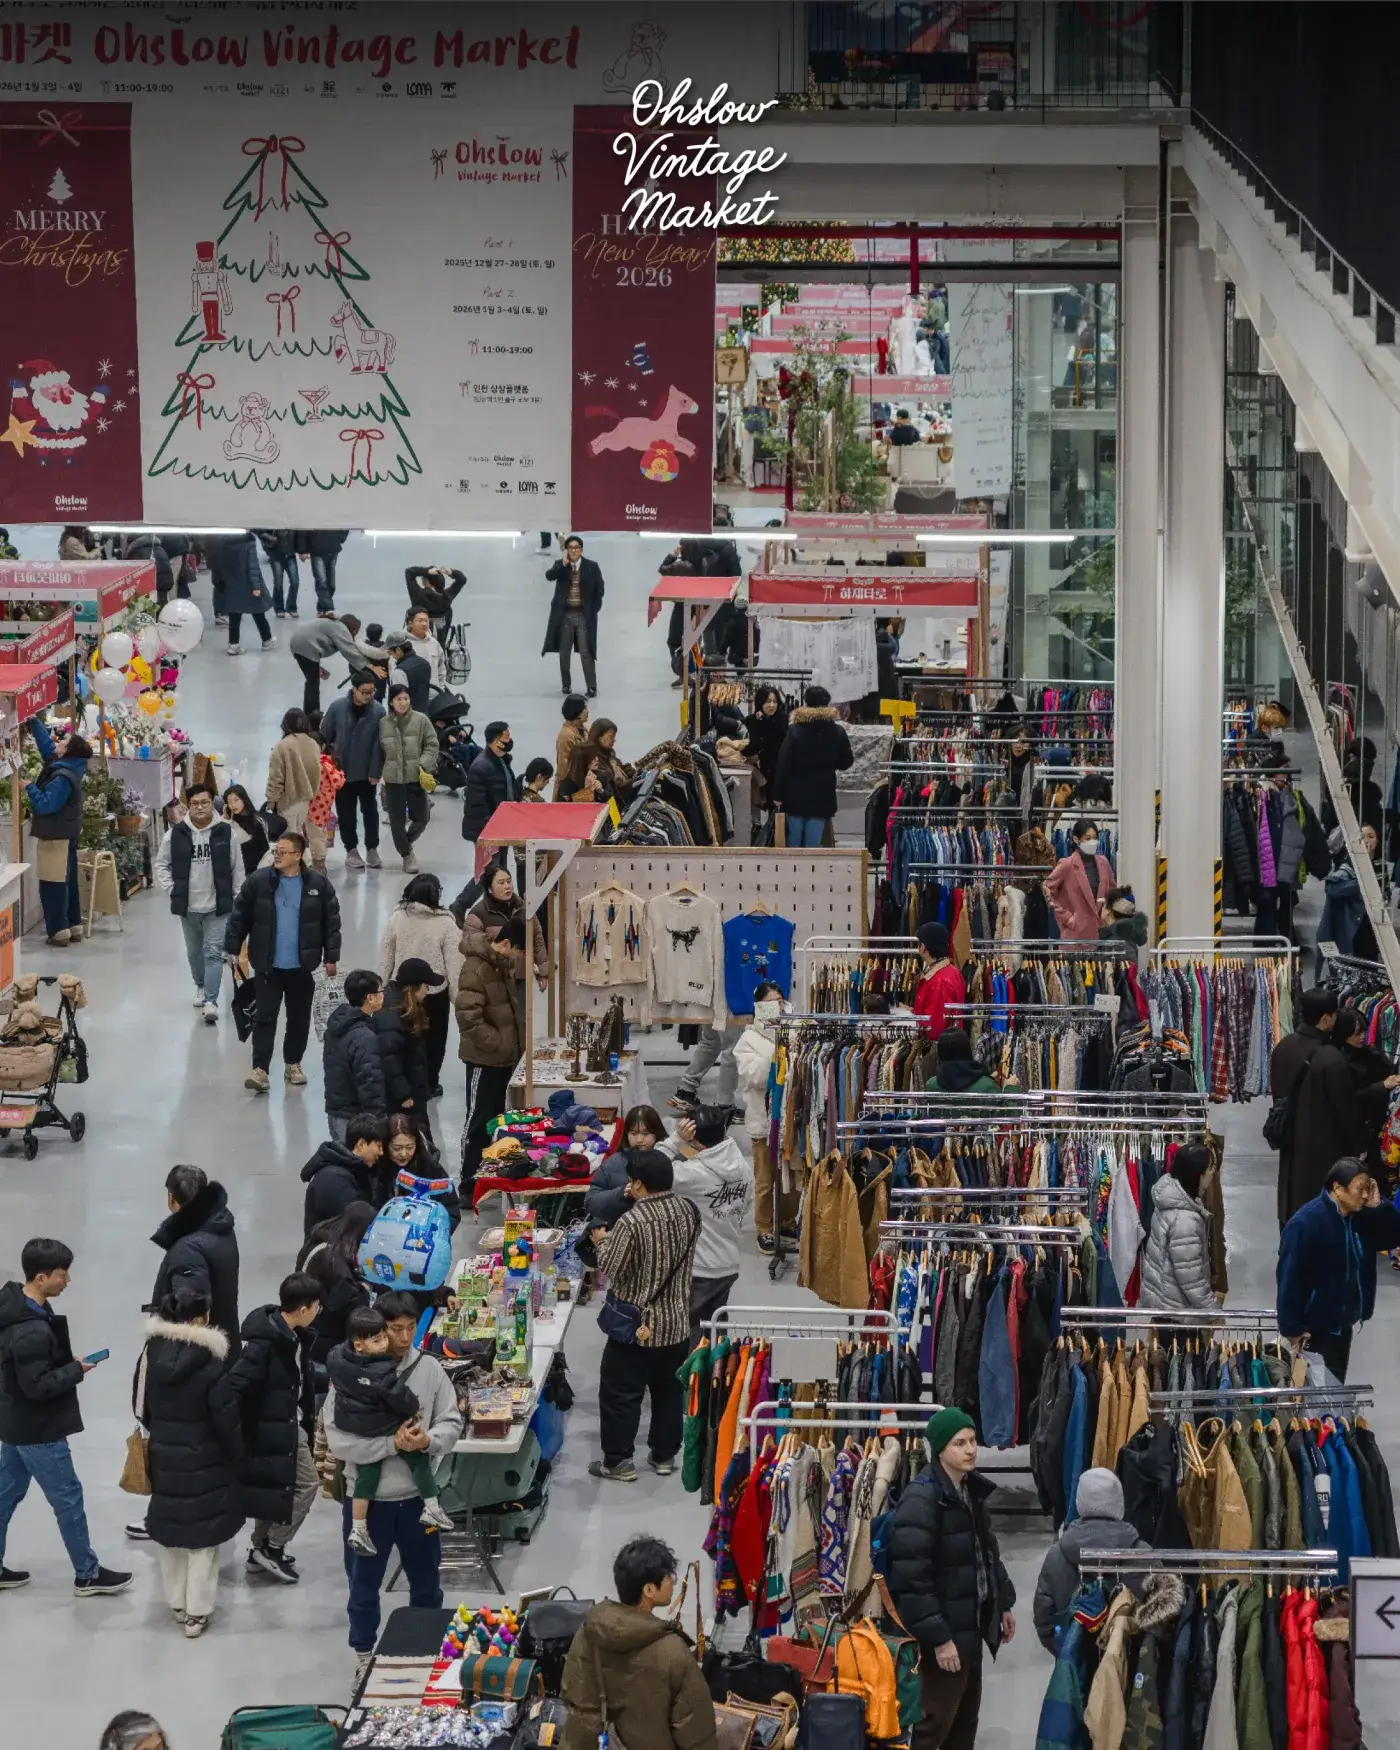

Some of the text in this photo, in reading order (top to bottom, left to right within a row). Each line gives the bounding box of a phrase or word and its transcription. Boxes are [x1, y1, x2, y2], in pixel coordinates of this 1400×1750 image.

[94, 20, 584, 78] Ohslow Vintage Market
[114, 84, 173, 93] 11:00-19:00
[455, 139, 543, 166] Ohslow
[457, 170, 541, 184] Vintage Market
[14, 210, 106, 231] MERRY
[0, 222, 128, 287] Christmas
[572, 233, 716, 278] New Year!
[444, 259, 472, 268] 2025년
[616, 266, 673, 287] 2026
[453, 305, 481, 314] 2026년
[482, 346, 533, 354] 11:00-19:00
[55, 494, 88, 506] Ohslow
[625, 503, 658, 515] Ohslow
